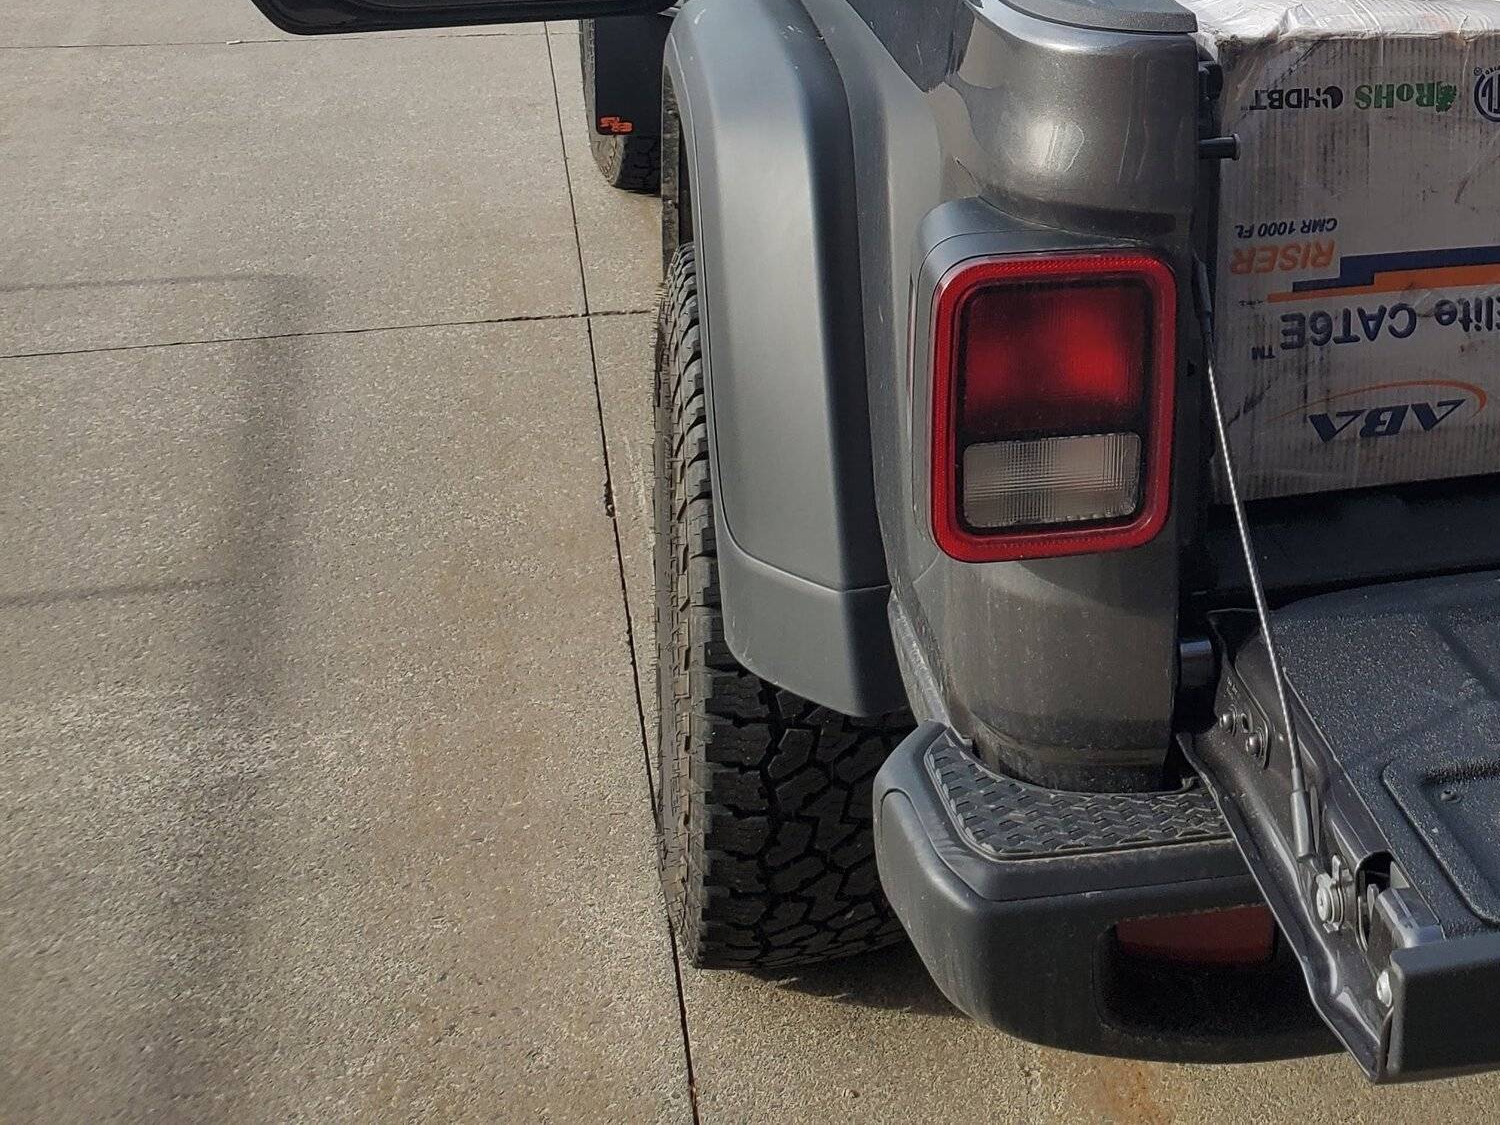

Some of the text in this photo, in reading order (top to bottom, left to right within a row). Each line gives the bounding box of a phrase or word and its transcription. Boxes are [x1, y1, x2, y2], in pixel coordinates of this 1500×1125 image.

[1354, 81, 1438, 110] RoHS
[1257, 221, 1297, 238] 1000
[1300, 217, 1338, 234] CMR
[1231, 240, 1336, 274] RISER
[1308, 398, 1466, 444] ABA
